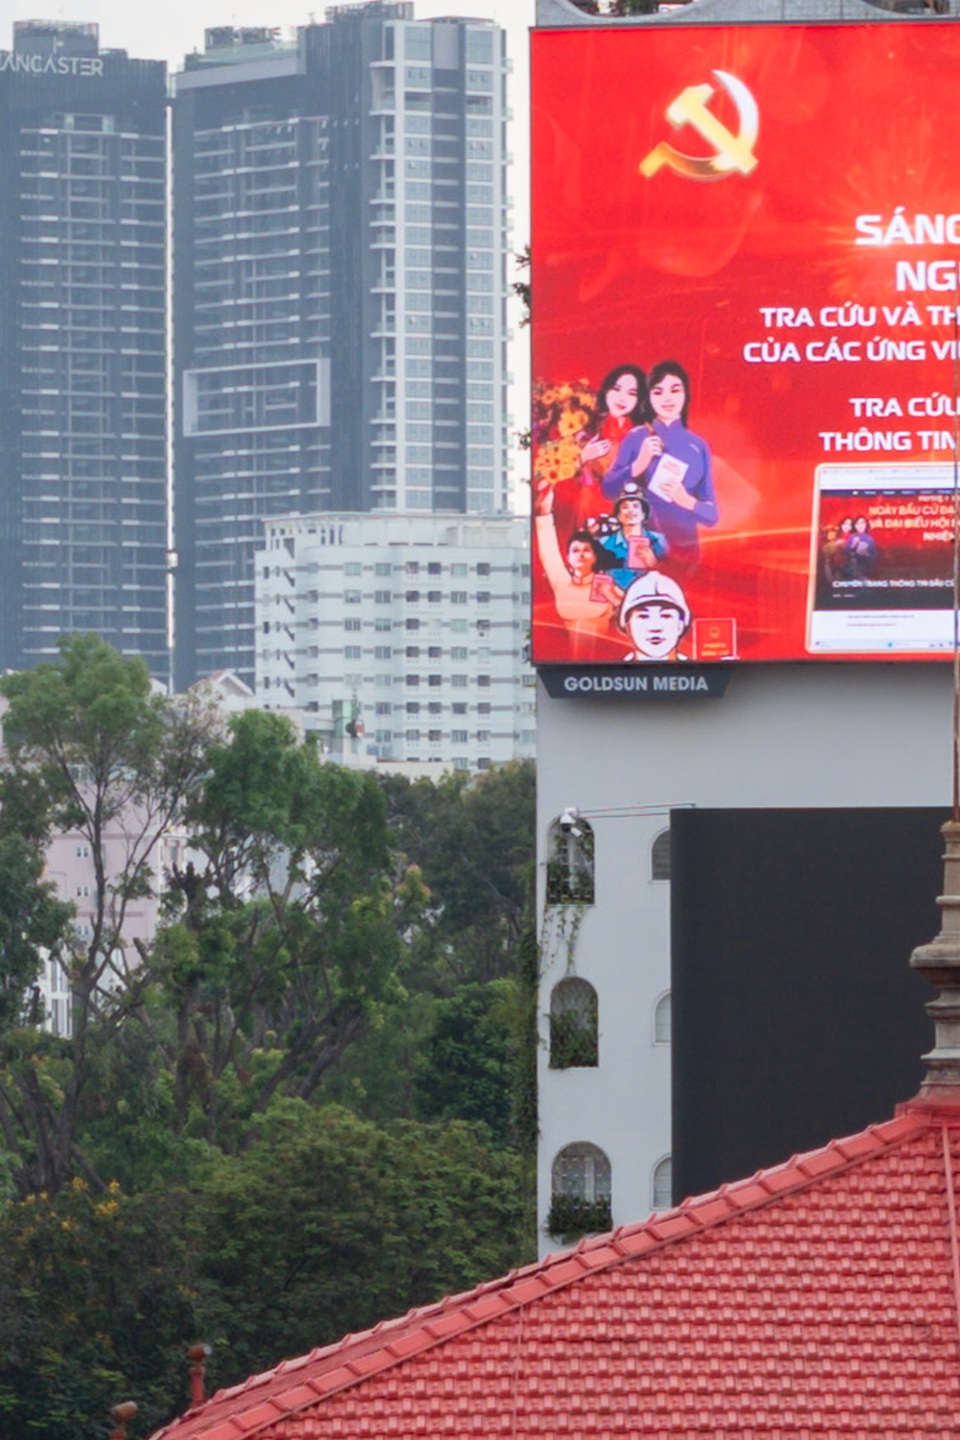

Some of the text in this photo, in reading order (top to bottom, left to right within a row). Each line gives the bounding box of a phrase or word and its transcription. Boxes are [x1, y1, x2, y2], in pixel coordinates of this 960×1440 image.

[0, 54, 104, 77] ANCASTER
[759, 307, 815, 328] TRA
[819, 301, 877, 327] CỨU
[882, 301, 922, 326] VÀ
[743, 336, 801, 363] CỦA
[805, 336, 861, 362] CÁC
[866, 336, 926, 361] ỨNG
[849, 397, 903, 417] TRA
[818, 427, 912, 451] THÔNG
[917, 430, 957, 450] TIN
[564, 676, 709, 691] GOLDSUN MEDIA
